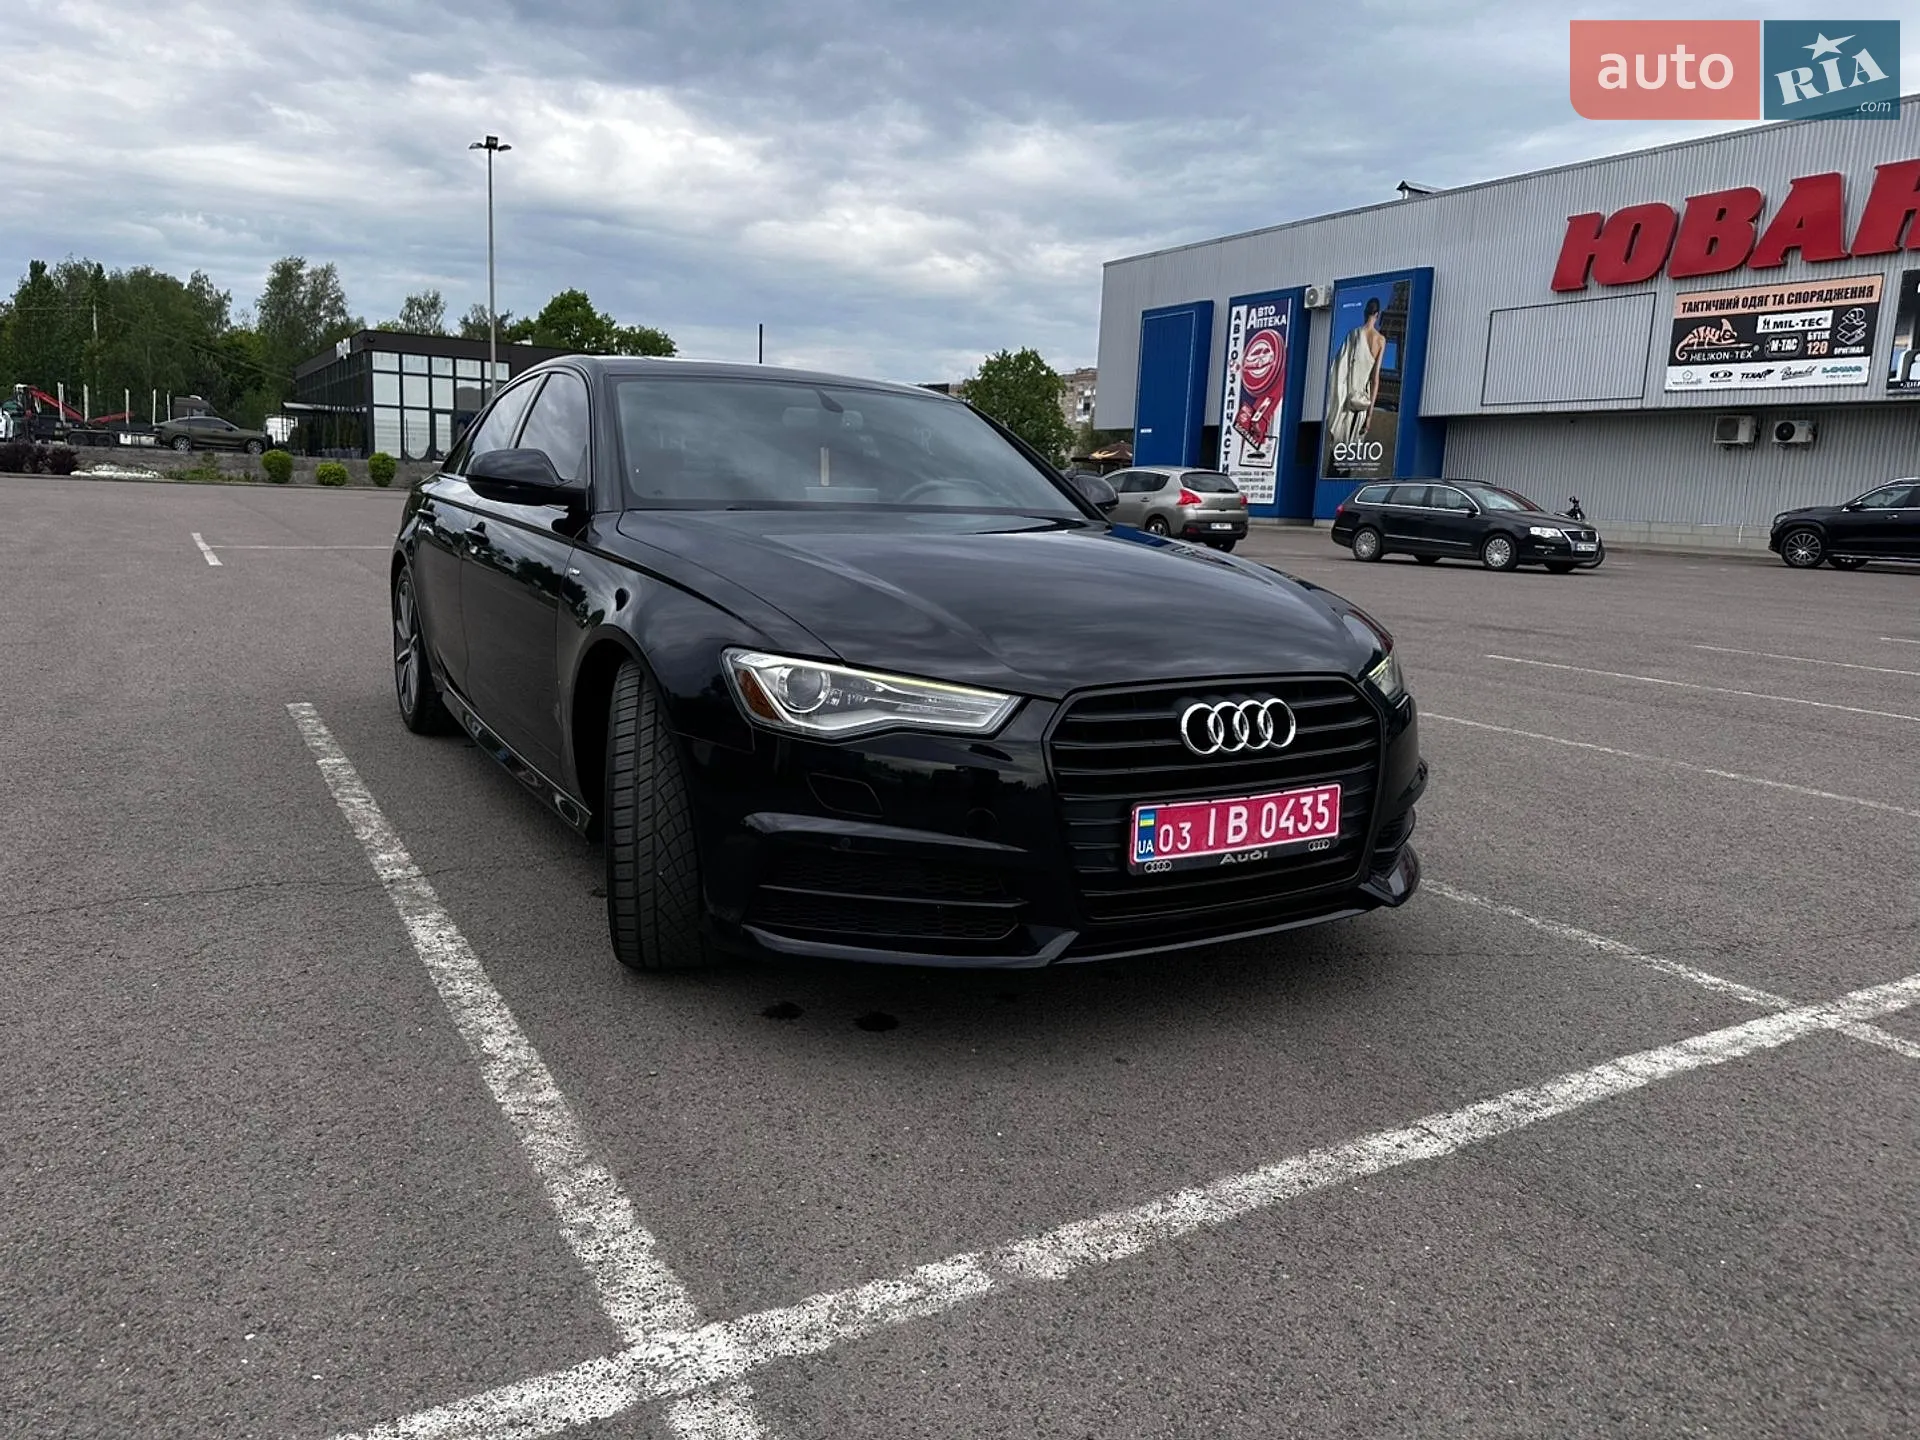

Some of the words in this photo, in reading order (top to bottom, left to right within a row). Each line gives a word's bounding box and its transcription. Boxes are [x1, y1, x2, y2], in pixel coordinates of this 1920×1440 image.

[1682, 295, 1740, 314] ТАКТИЧНИЙ
[1741, 294, 1771, 309] ОДЯГ
[1772, 293, 1784, 306] ТА
[1786, 285, 1874, 304] СПОРЯДЖЕННЯ
[1690, 348, 1753, 362] HELIKON-TEX
[1807, 341, 1828, 355] 120
[1333, 439, 1383, 461] estro
[1138, 840, 1154, 854] UA
[1158, 822, 1191, 853] 03
[1261, 793, 1329, 838] 0435
